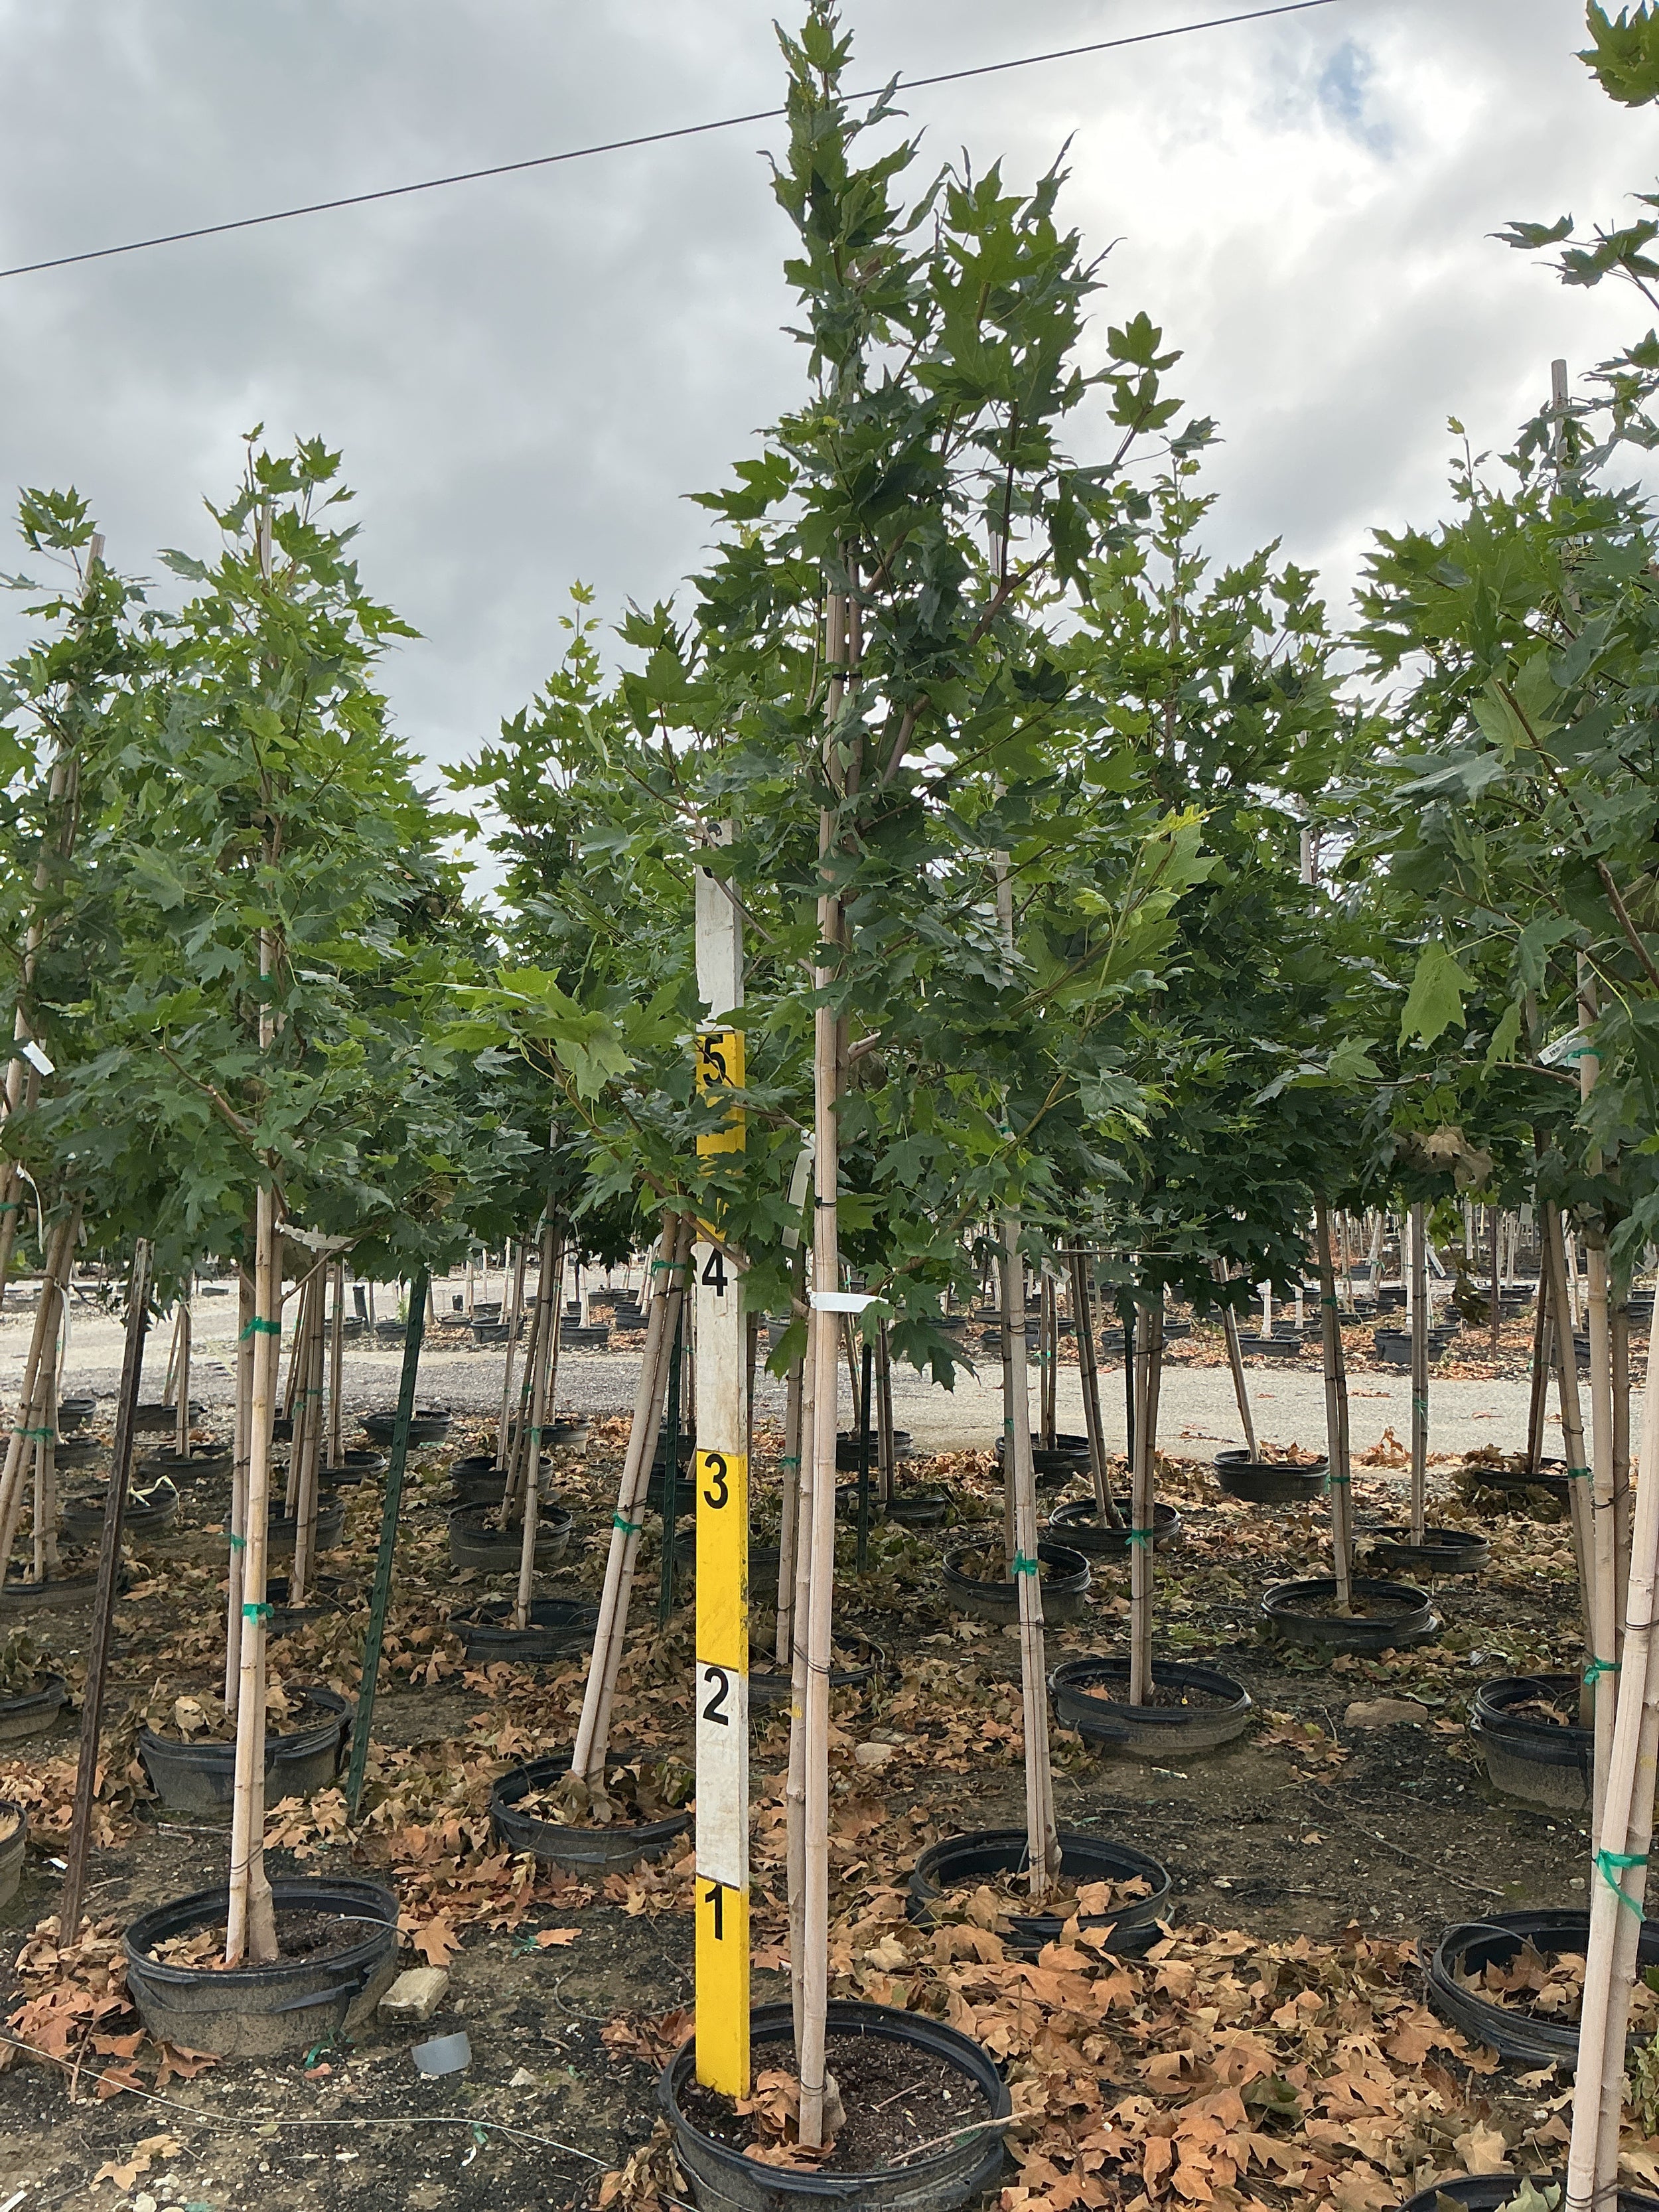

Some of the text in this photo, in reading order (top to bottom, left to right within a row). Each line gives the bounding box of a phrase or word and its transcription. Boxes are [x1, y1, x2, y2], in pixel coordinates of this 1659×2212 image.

[703, 1034, 726, 1088] 5
[701, 1248, 728, 1297] 4
[703, 1453, 729, 1509] 3
[702, 1666, 729, 1726] 2
[705, 1883, 723, 1941] 1
